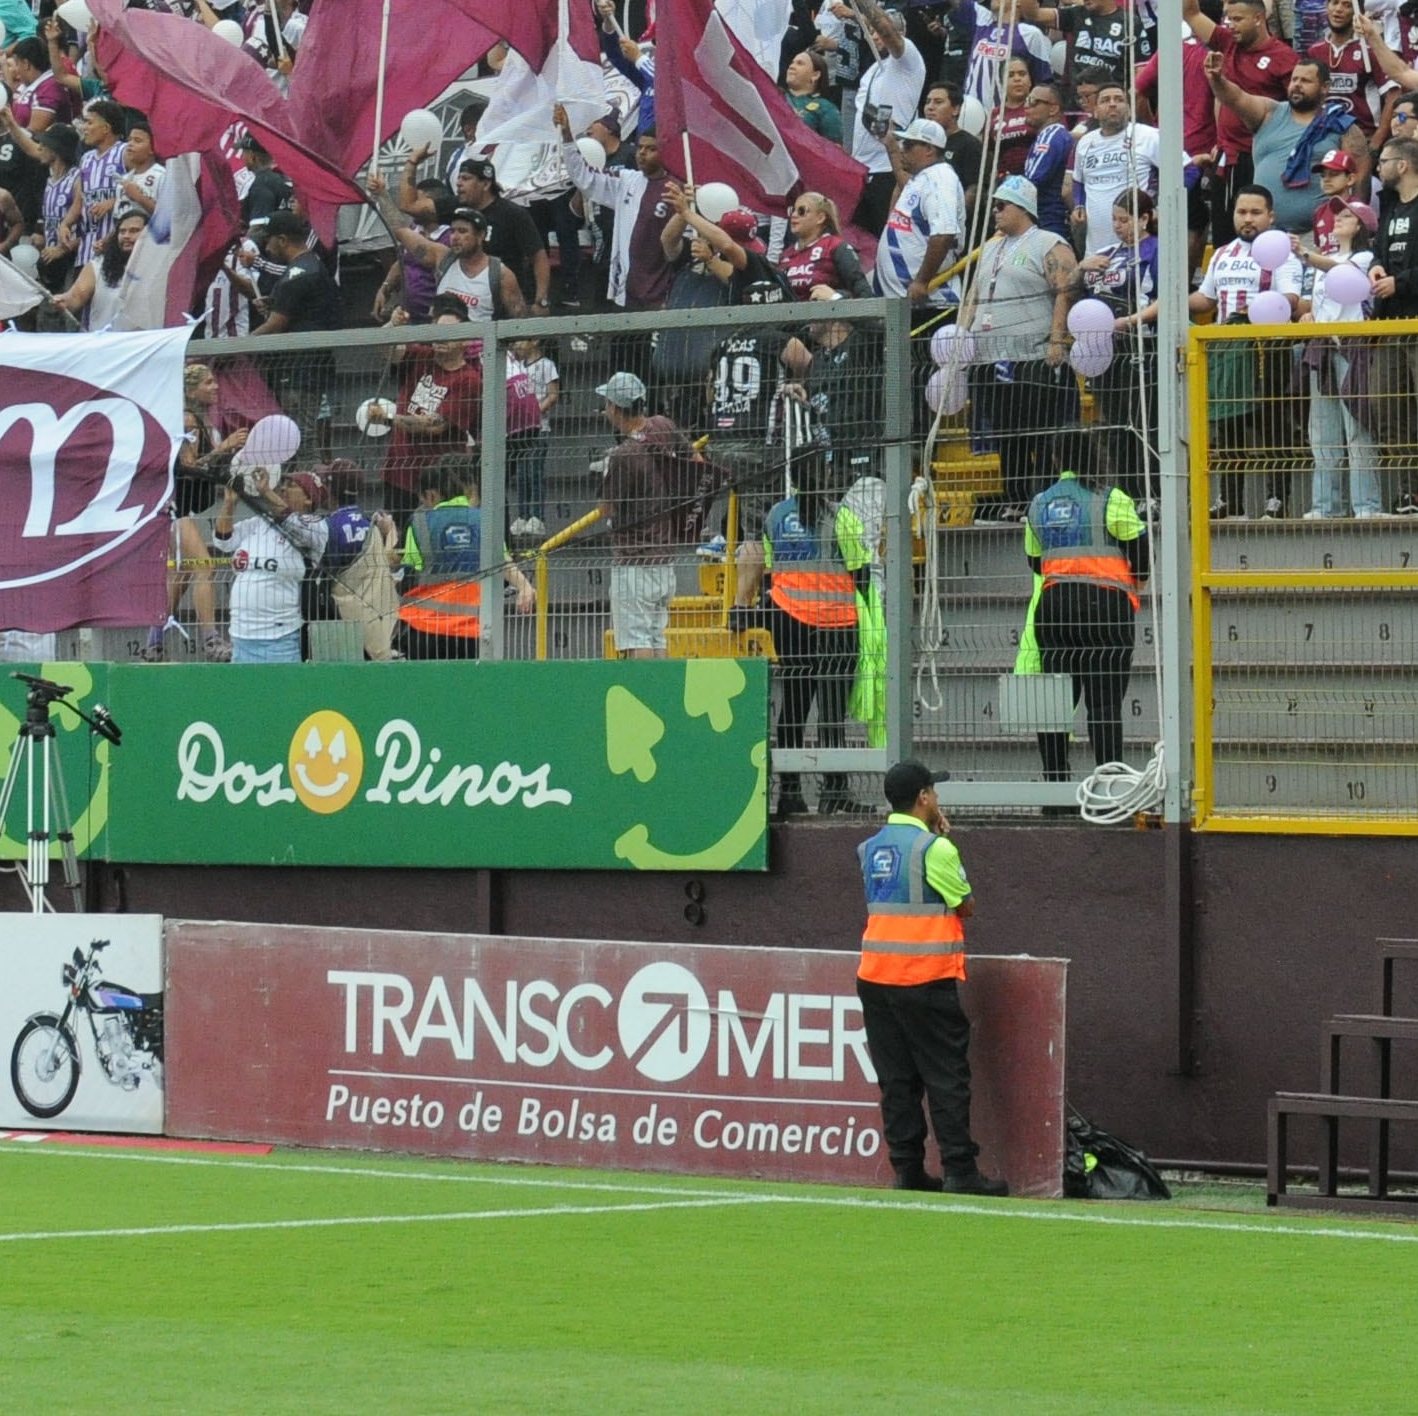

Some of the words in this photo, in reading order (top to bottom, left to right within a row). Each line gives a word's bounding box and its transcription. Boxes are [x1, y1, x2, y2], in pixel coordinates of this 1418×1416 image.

[253, 556, 278, 573] LG
[177, 720, 295, 806] Dos
[366, 718, 573, 808] Pinos
[325, 1084, 444, 1130] Puesto
[459, 1091, 502, 1133] de
[518, 1097, 617, 1143] Bolsa
[632, 1103, 678, 1146] de
[693, 1109, 881, 1158] Comercio
